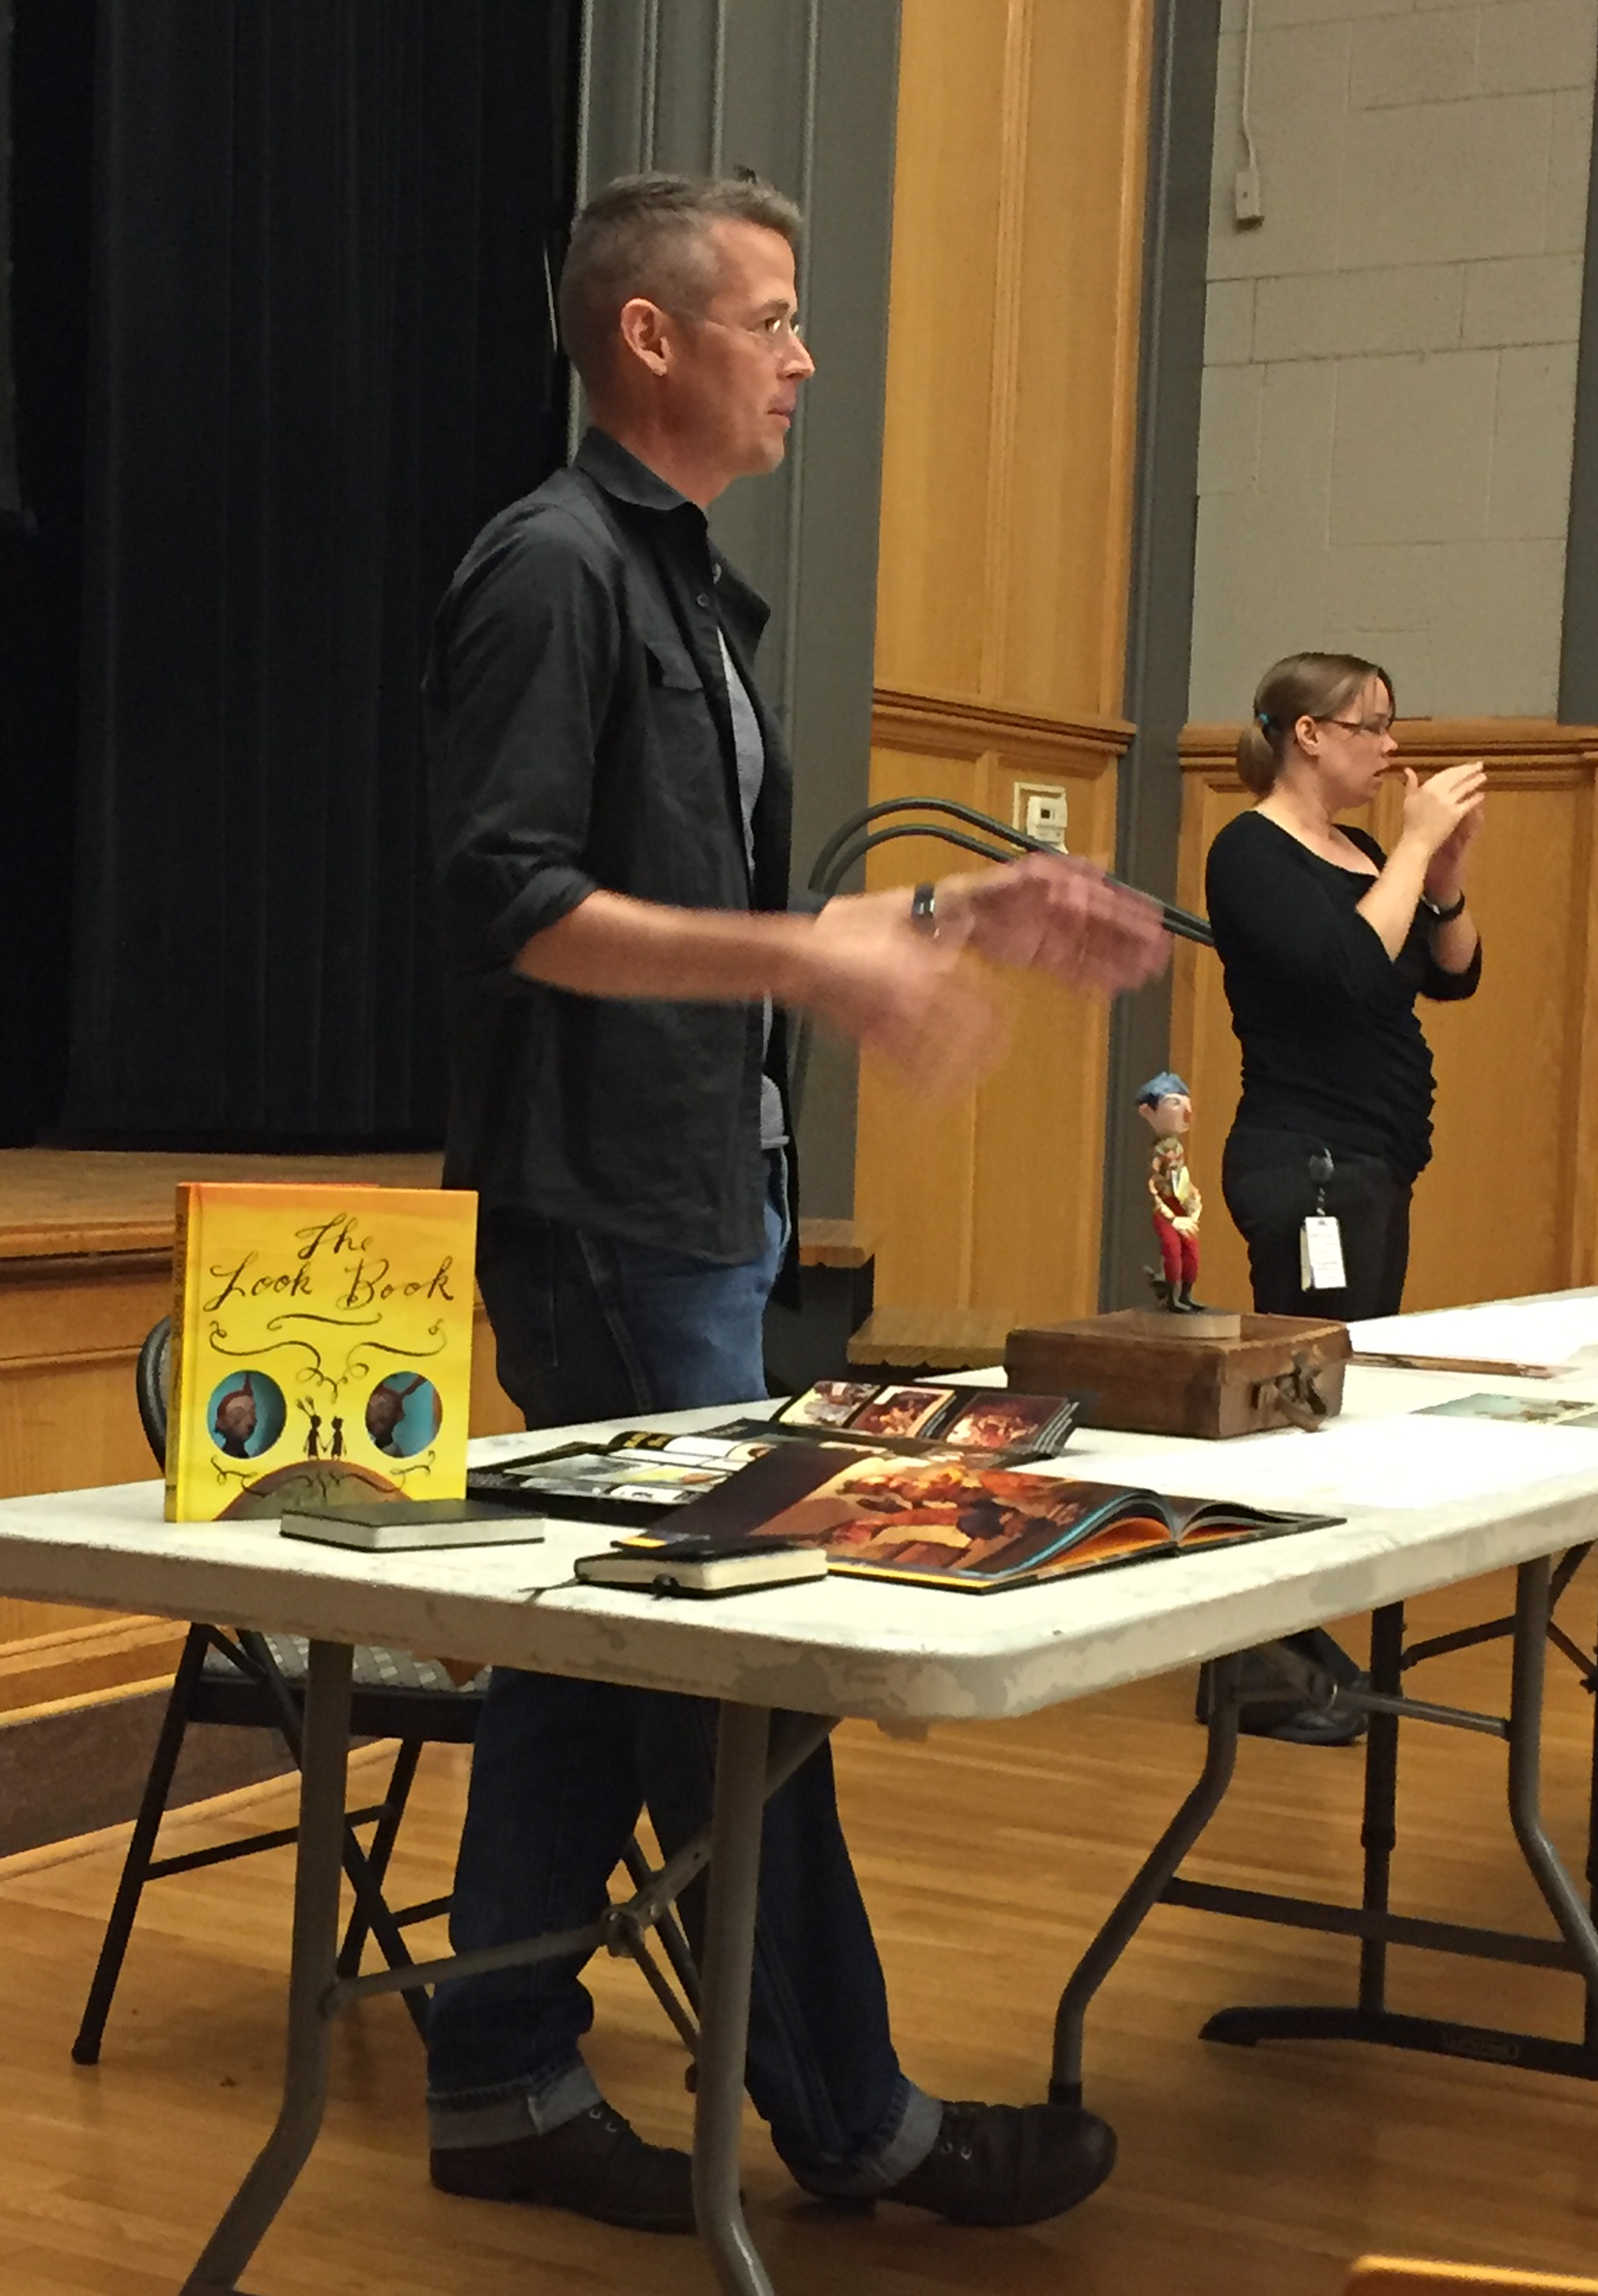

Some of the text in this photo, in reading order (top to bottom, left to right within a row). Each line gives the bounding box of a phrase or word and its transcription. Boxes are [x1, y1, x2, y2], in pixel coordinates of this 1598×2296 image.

[294, 1212, 374, 1259] The
[202, 1252, 455, 1312] Look Book
